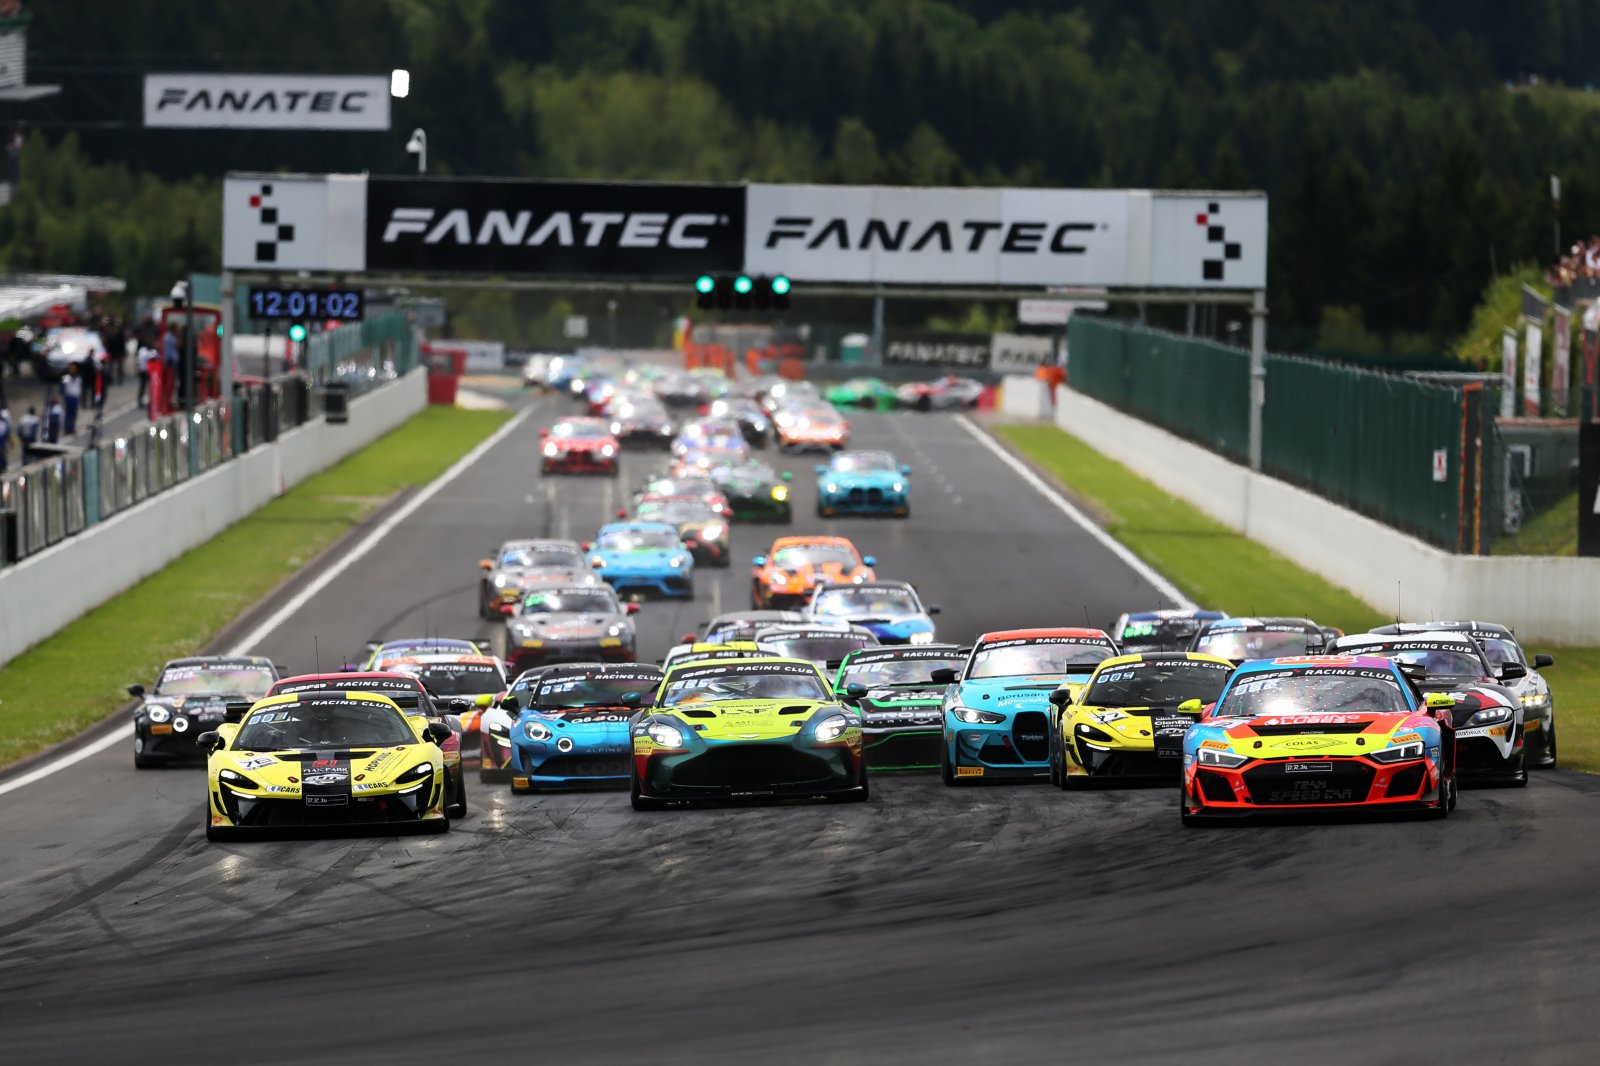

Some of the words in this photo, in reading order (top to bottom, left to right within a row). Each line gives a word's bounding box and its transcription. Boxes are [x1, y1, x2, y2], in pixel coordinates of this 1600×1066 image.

[157, 88, 370, 113] FANATEC
[382, 208, 717, 248] FANATEC
[765, 217, 1097, 254] FANATEC
[252, 290, 359, 317] 12:01:02
[1473, 631, 1500, 639] CLUB
[1442, 644, 1473, 653] CLUB
[784, 666, 813, 674] CLUB
[1202, 663, 1231, 671] CLUB
[1360, 671, 1395, 680] CLUB
[383, 681, 412, 689] CLUB
[998, 693, 1044, 701] Borusan
[361, 701, 392, 710] CLUB
[1391, 733, 1420, 743] PIRELLI
[1202, 741, 1229, 749] PIRELLI
[1271, 790, 1320, 800] SPEED
